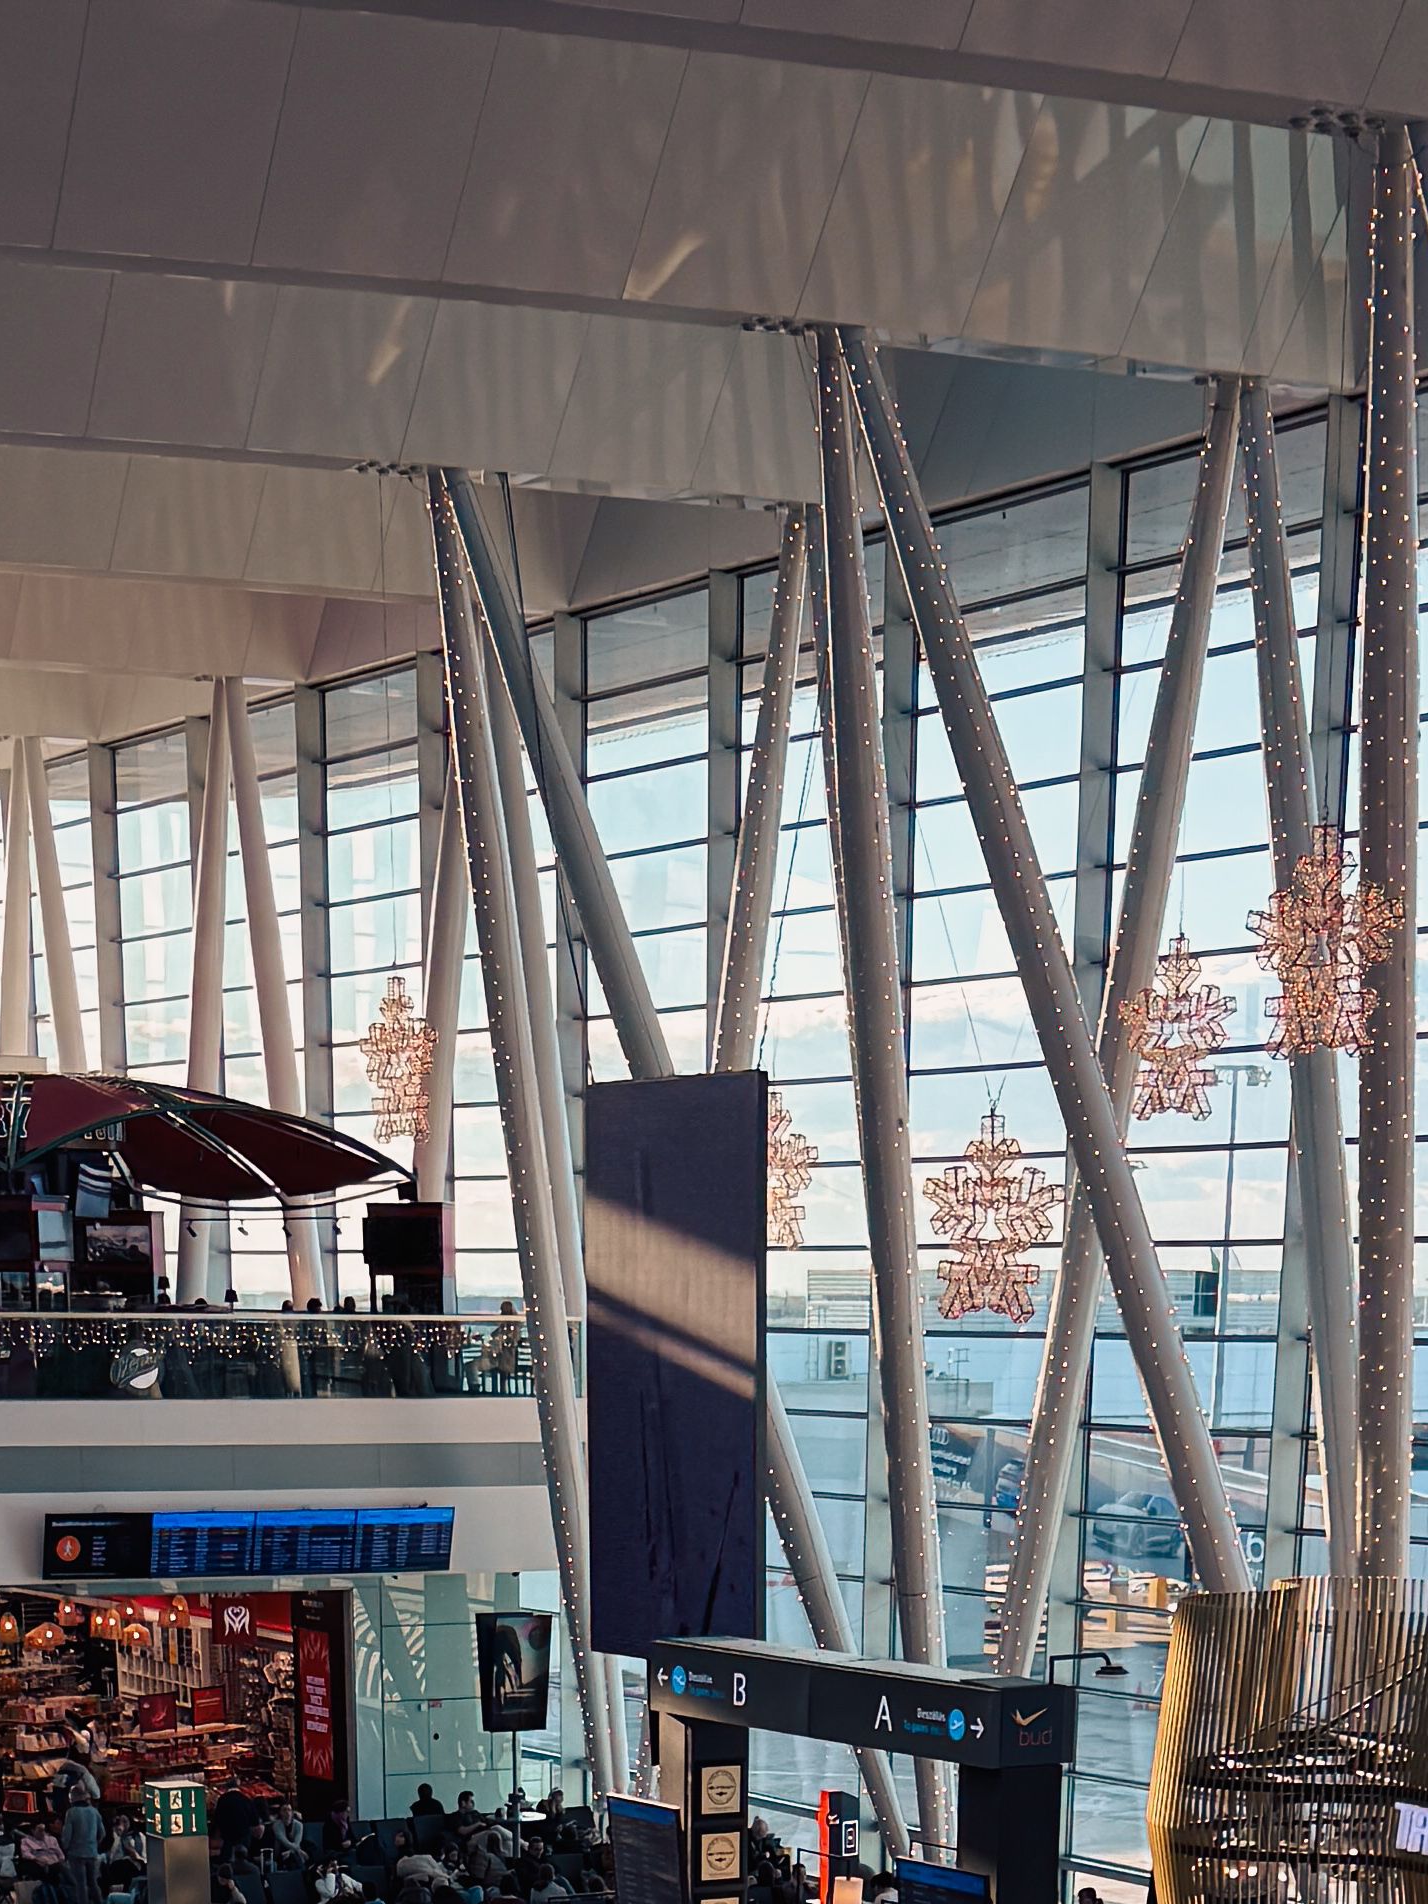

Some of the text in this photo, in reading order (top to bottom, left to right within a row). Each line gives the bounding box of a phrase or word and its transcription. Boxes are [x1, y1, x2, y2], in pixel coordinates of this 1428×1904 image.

[733, 1672, 746, 1706] B
[874, 1695, 893, 1732] A
[1019, 1727, 1053, 1746] bud
